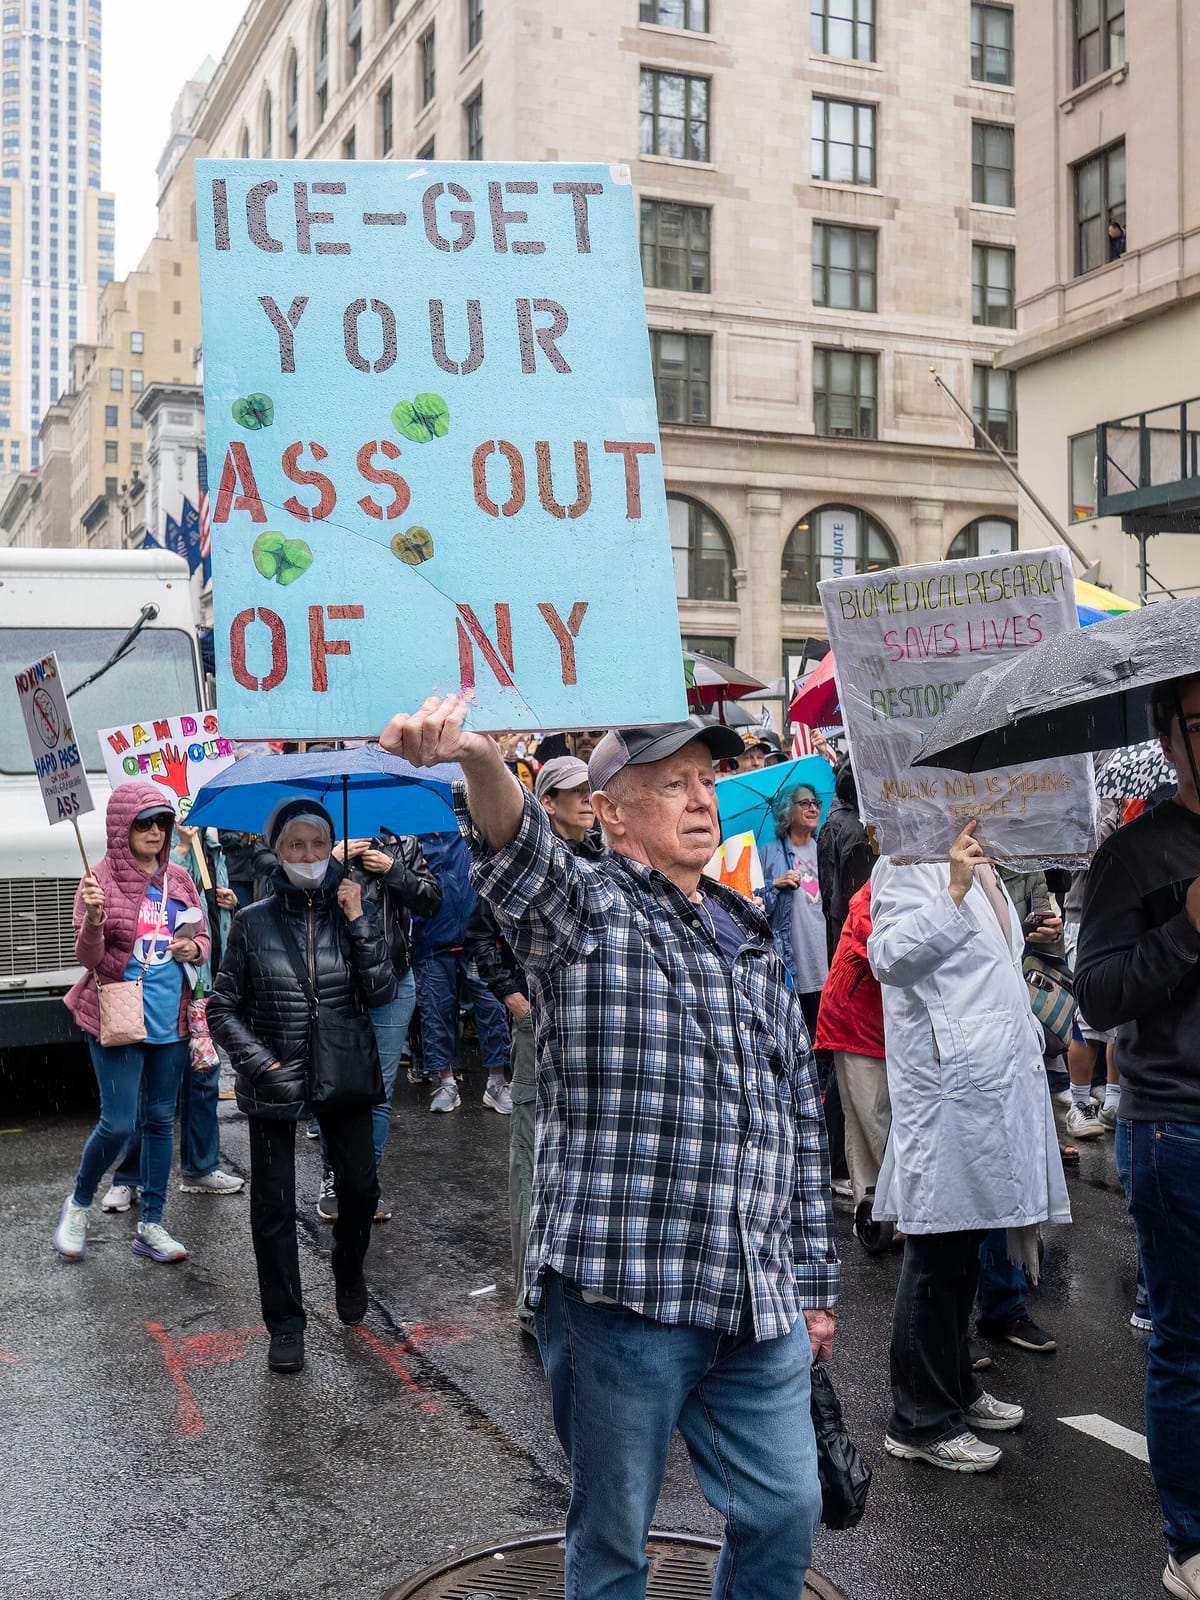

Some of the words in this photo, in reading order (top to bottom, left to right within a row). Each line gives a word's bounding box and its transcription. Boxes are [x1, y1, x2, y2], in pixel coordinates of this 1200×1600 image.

[258, 295, 572, 376] YOUR
[213, 440, 411, 523] ASS
[471, 440, 656, 520] OUT
[832, 523, 844, 578] ADUATE
[838, 574, 964, 620] BIOMEDICAL
[965, 559, 1066, 604] RESEARCH
[229, 603, 365, 692] OF
[457, 601, 589, 688] NY
[883, 623, 959, 662] SAVES
[967, 613, 1044, 652] LIVES
[107, 715, 219, 755] HANDS
[123, 751, 162, 776] OFF
[187, 738, 233, 763] OUR
[34, 752, 58, 779] HARD
[58, 743, 81, 770] PASS
[56, 792, 80, 819] ASS
[984, 775, 1002, 796] IS
[137, 910, 169, 925] PRIDE
